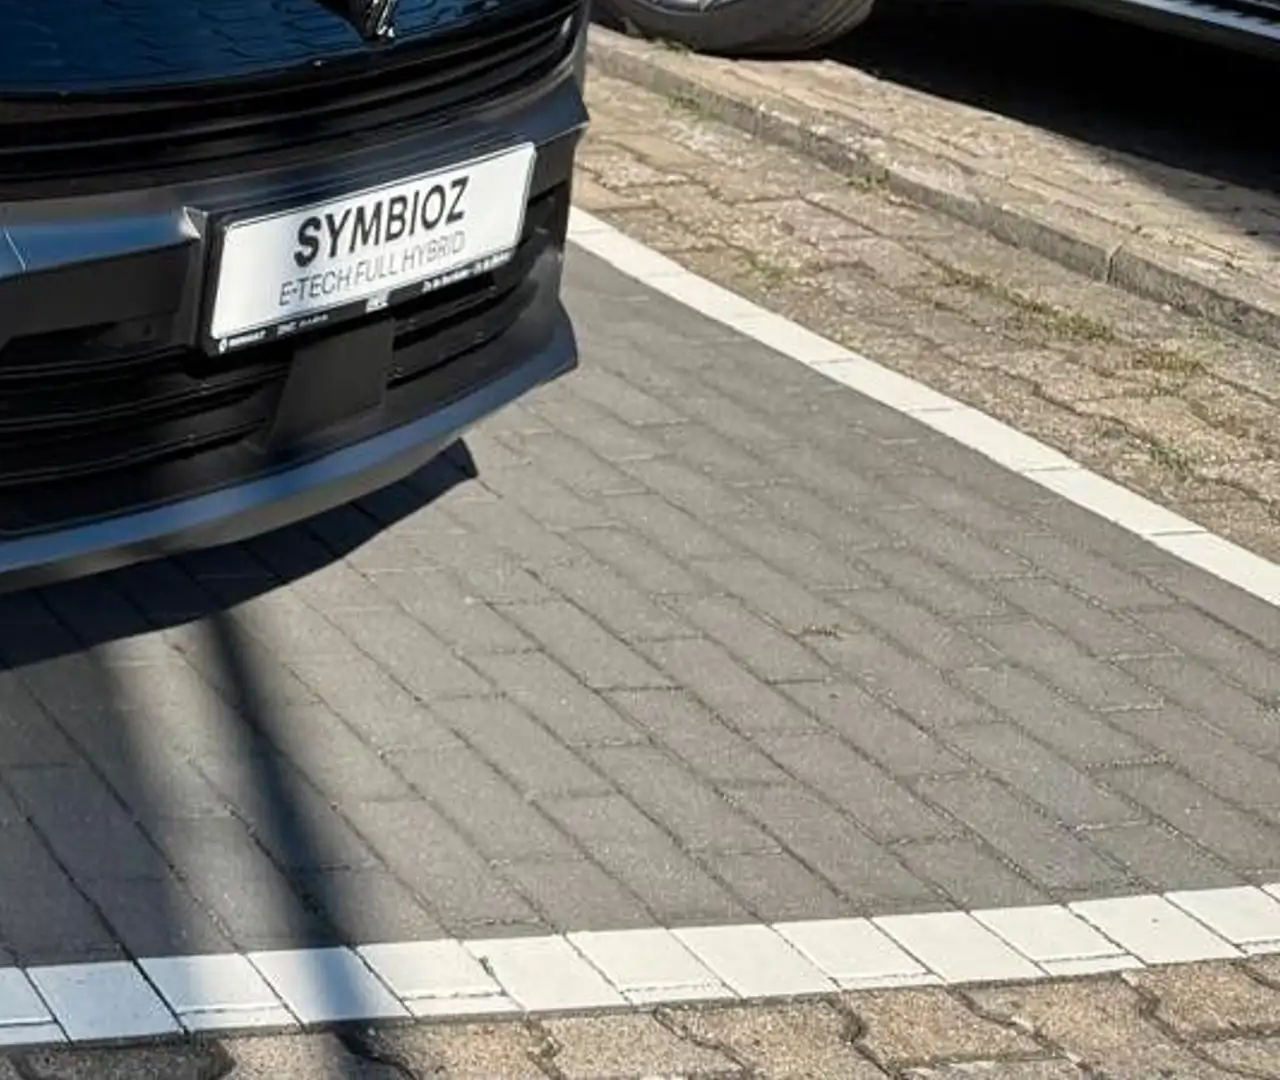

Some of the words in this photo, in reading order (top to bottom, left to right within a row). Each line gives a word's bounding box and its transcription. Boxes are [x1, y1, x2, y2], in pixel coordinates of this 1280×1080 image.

[293, 176, 469, 267] SYMBIOZ
[278, 266, 354, 307] E-TECH
[353, 253, 397, 286] FULL
[402, 230, 466, 271] HYBRID
